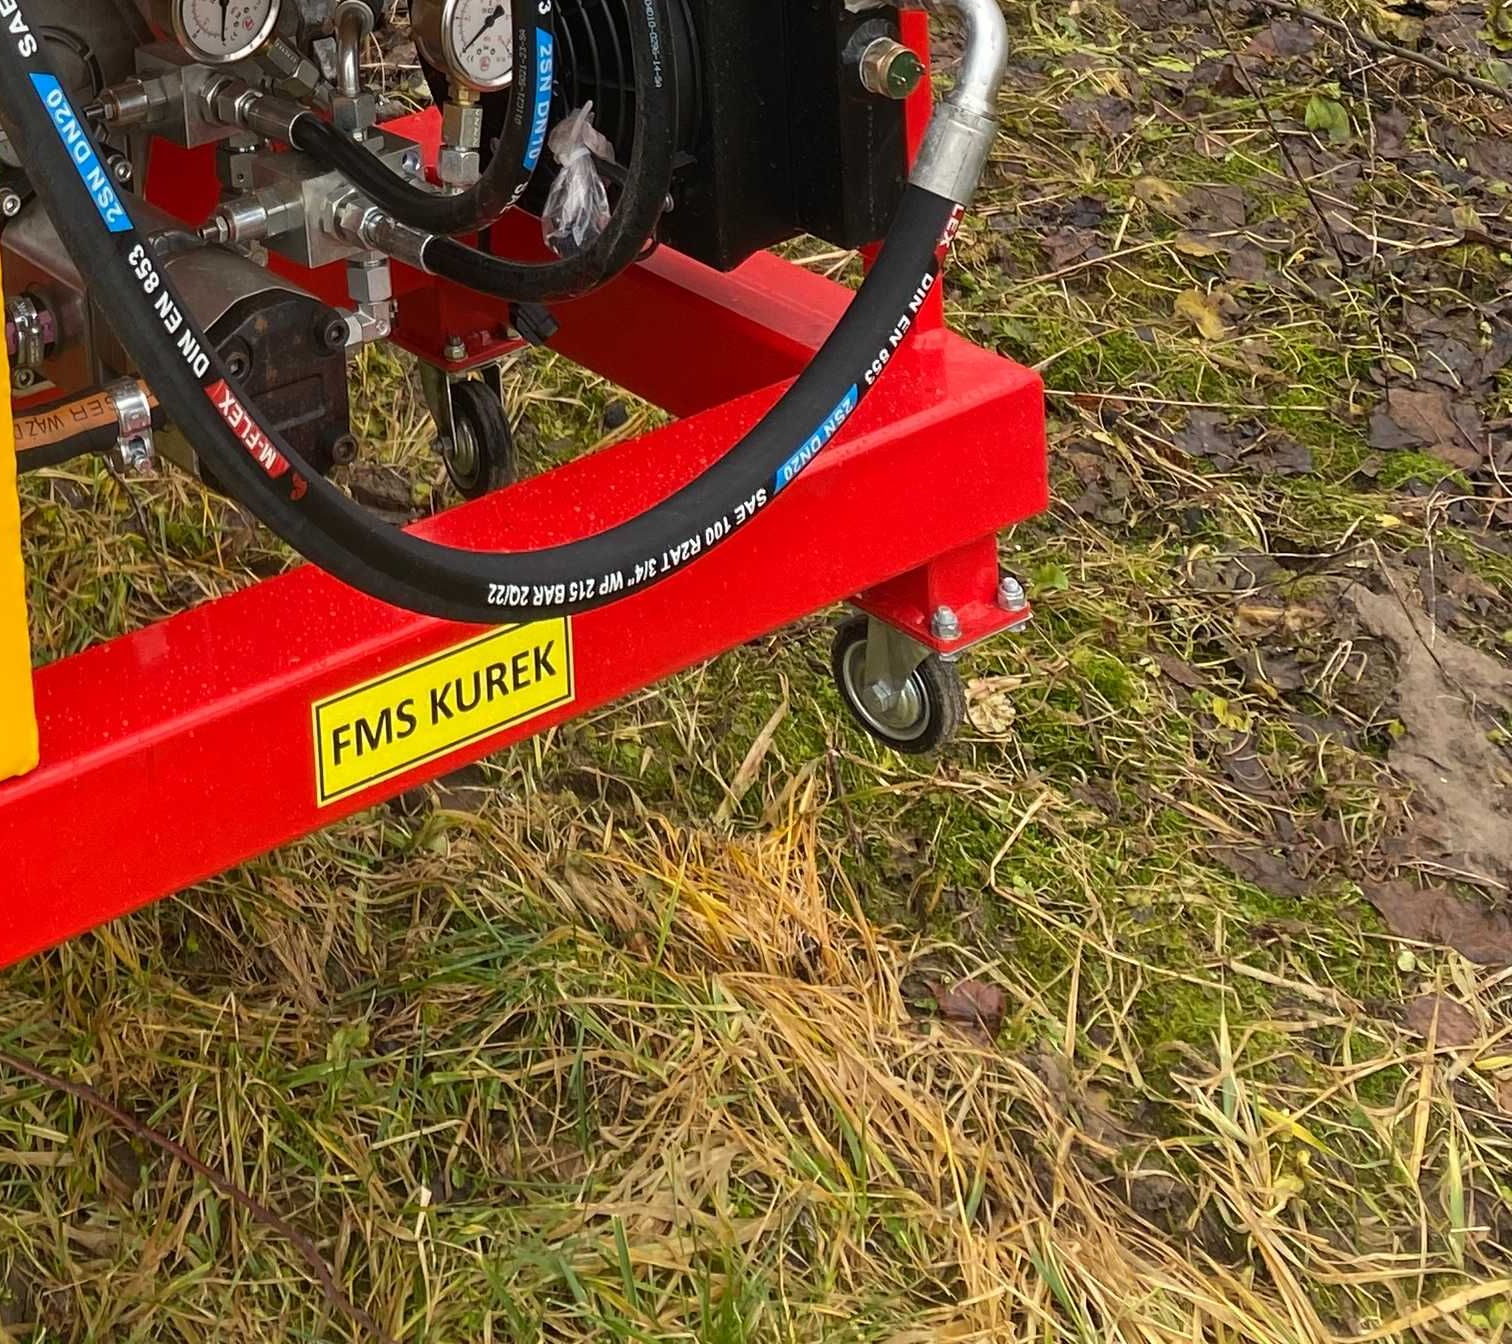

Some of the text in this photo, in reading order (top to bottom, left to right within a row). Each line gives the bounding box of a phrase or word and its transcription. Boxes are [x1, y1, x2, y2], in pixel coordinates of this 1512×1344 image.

[539, 43, 554, 93] 2SN
[45, 87, 92, 165] DN20
[528, 99, 551, 161] DN10
[85, 169, 126, 224] 2SN
[128, 243, 161, 294] 853
[908, 271, 934, 314] DIN
[153, 295, 181, 334] EN
[887, 315, 912, 350] EN
[177, 327, 211, 379] DIN
[864, 348, 891, 386] 853
[217, 386, 279, 474] M-FLEX
[822, 398, 855, 438] 2SN
[783, 436, 824, 483] DN20
[733, 487, 768, 520] SAE
[659, 531, 703, 570] R2AT
[705, 516, 734, 546] 100
[568, 577, 595, 603] 215
[597, 568, 625, 594] WP
[627, 557, 659, 587] 3/4"
[531, 581, 566, 607] BAR
[331, 638, 558, 767] FMS KUREK
